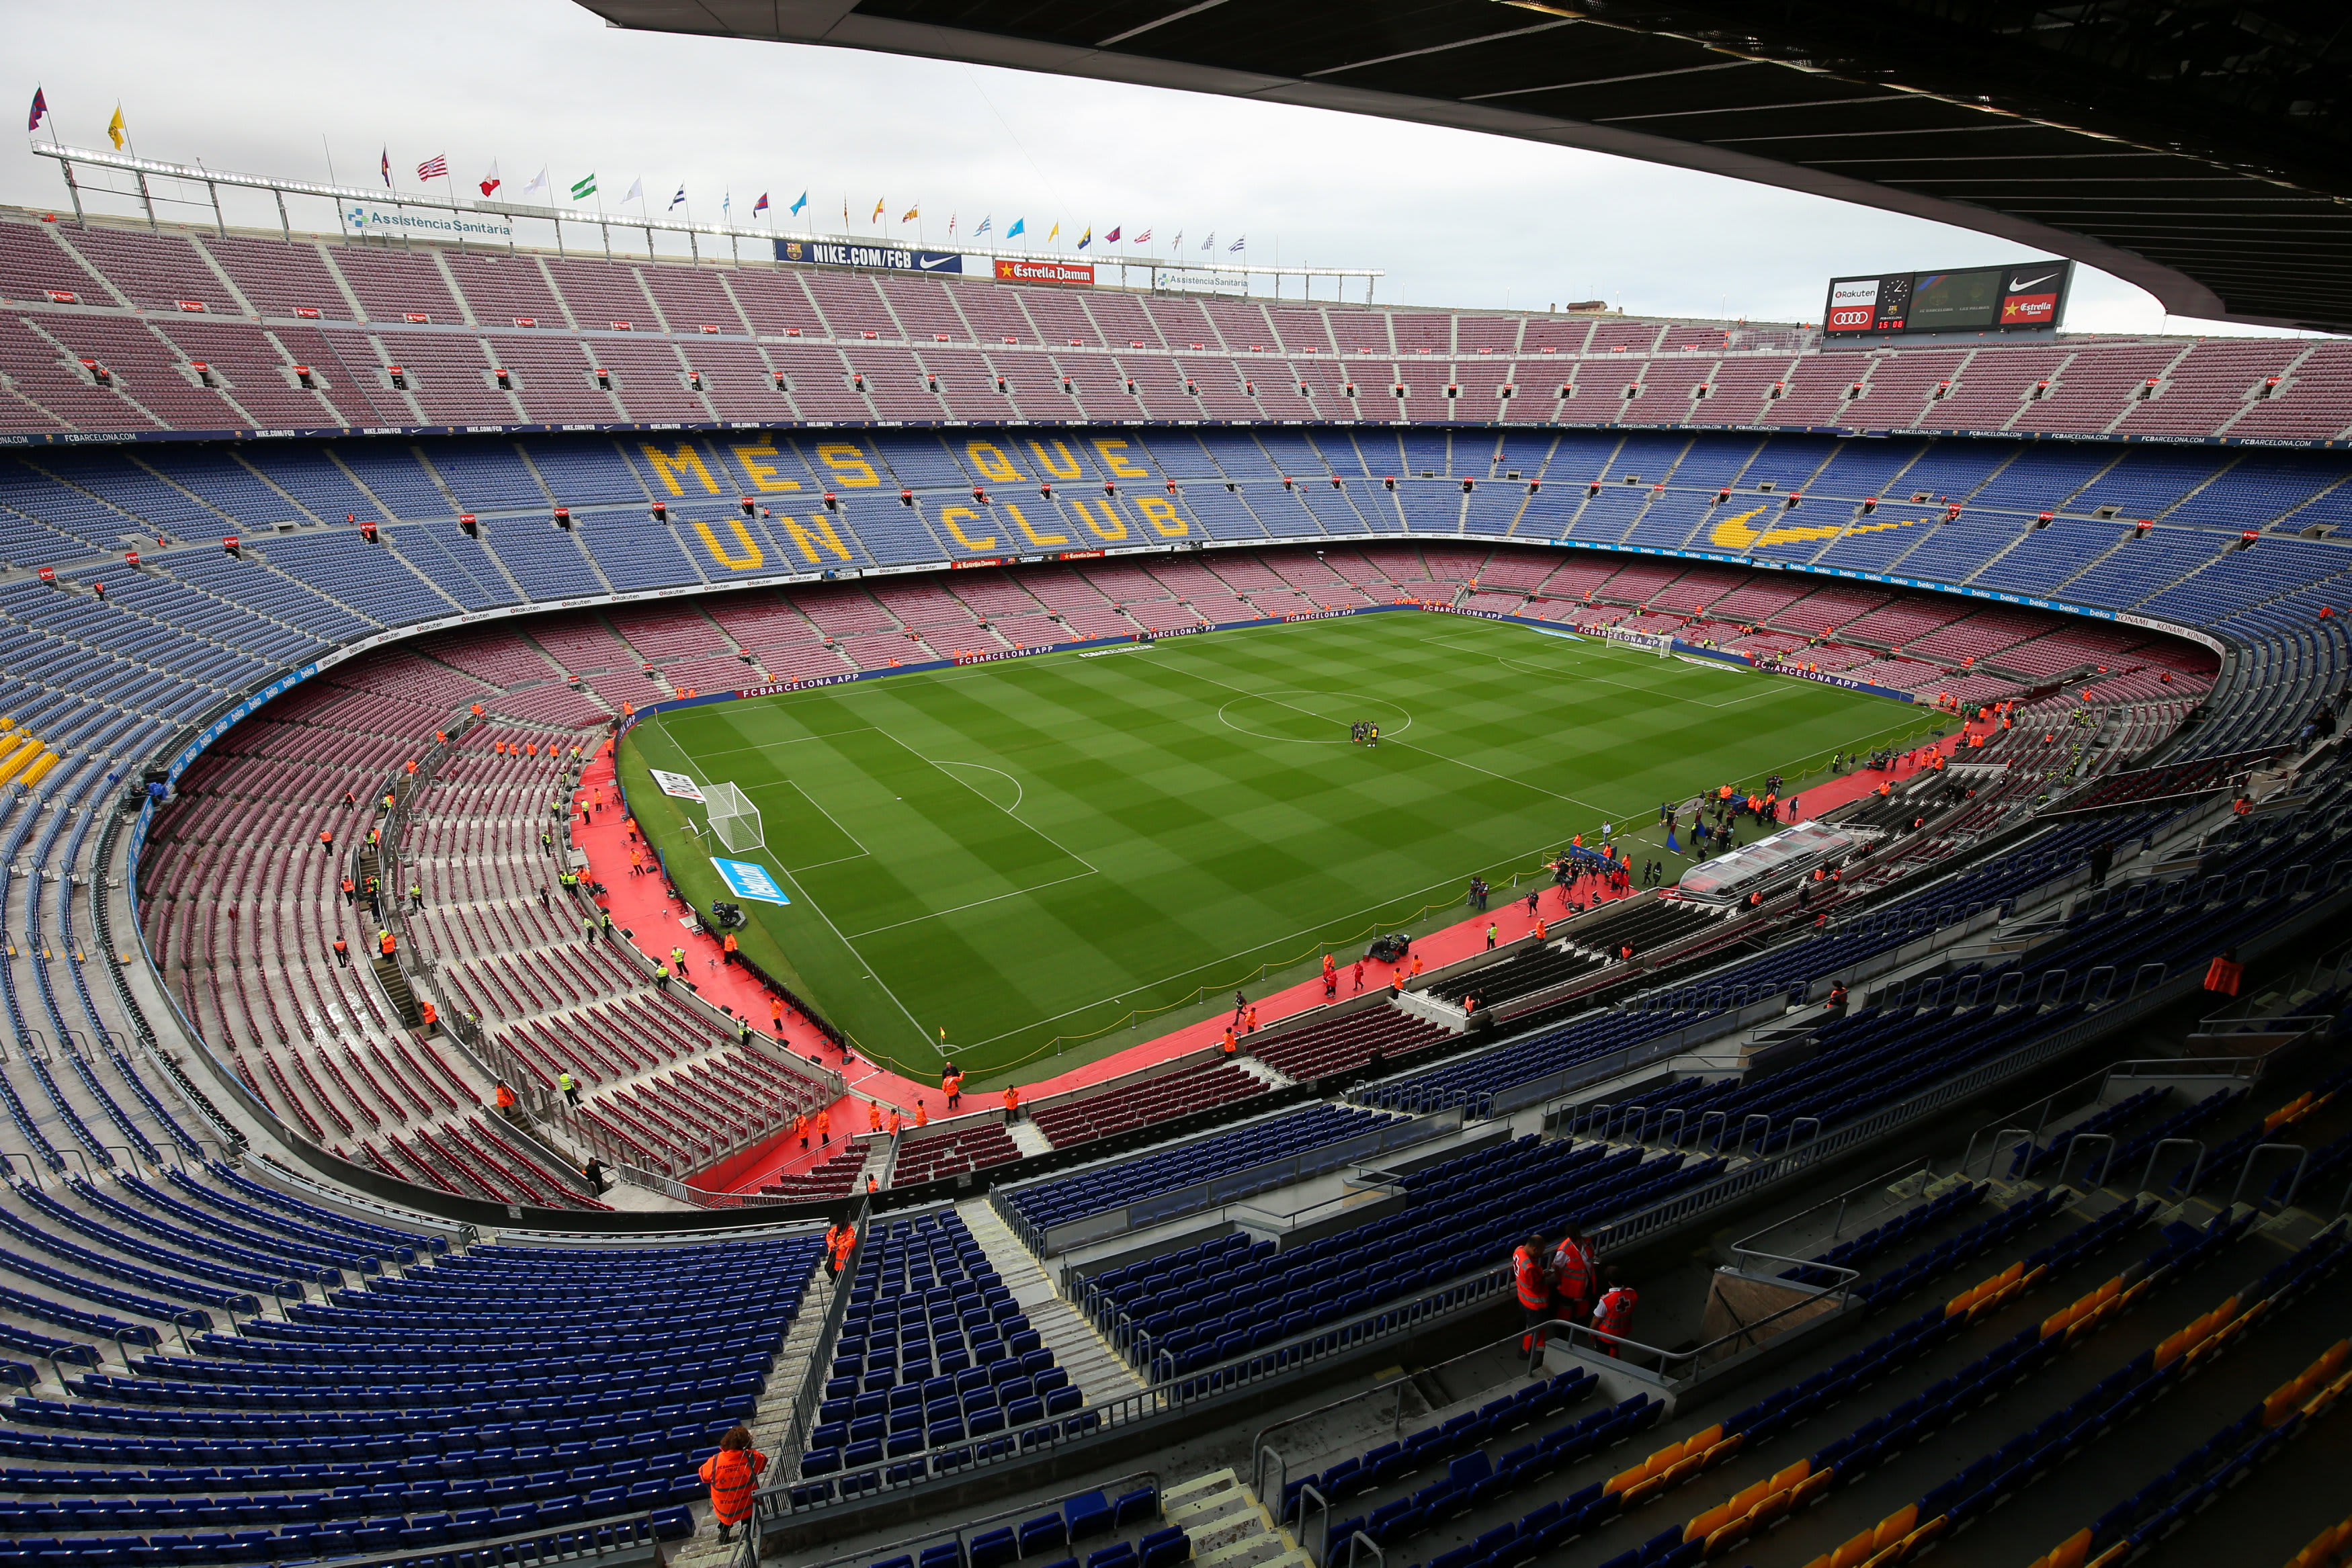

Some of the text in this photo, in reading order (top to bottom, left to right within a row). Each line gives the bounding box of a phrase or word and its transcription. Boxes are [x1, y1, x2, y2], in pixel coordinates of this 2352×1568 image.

[372, 211, 511, 236] Assistència Sanitària
[812, 244, 912, 269] NIKE.COM/FCB
[1013, 263, 1091, 281] Estrella Damm
[1170, 275, 1248, 288] Assistència Sanitària
[2020, 302, 2051, 311] Estrella
[1878, 321, 1888, 329] 15
[65, 433, 136, 442] FCBARCELONA.COM
[2240, 439, 2311, 447] FCBARCELONA.COM
[643, 432, 1148, 496] MÉS QUE
[694, 498, 1188, 570] UN CLUB
[962, 560, 979, 568] Estrella
[1790, 563, 1806, 571] beko
[1814, 566, 1831, 574] beko
[1839, 570, 1856, 578] beko
[1864, 573, 1882, 581] beko
[1890, 577, 1908, 585] beko
[1917, 581, 1935, 589] beko
[1944, 585, 1962, 593] beko
[1972, 589, 1990, 598] beko
[2000, 594, 2019, 603] beko
[2029, 599, 2049, 608] beko
[1423, 605, 1503, 620] FCBARCELONA APP
[2059, 603, 2079, 613] beko
[2089, 609, 2110, 618] beko
[462, 612, 490, 622] Rakuten
[1286, 609, 1355, 622] FCBARCELONA APP
[2115, 613, 2148, 626] KONAMI
[417, 621, 443, 632] Rakuten
[2156, 622, 2184, 636] KONAMI
[378, 631, 400, 642] Rakuten
[1136, 627, 1197, 640] FBARCELONA
[1579, 627, 1642, 644] FCBARCELONA
[1646, 638, 1664, 647] APP
[2186, 630, 2208, 644] KONAMI
[349, 643, 366, 654] Rakuten
[1079, 644, 1155, 658] FCBARCELONA.COM
[323, 655, 339, 667] Rakuten
[959, 645, 1054, 666] FCBARCELONA APP
[300, 666, 315, 679] beko
[1755, 660, 1831, 684] FCARCELONA
[1836, 679, 1858, 689] APP
[282, 676, 296, 689] beko
[743, 673, 859, 698] FCBARCELONA APP
[265, 686, 278, 699] beko
[248, 697, 261, 709] beko
[231, 709, 245, 722] beko
[214, 720, 228, 734] beko
[200, 734, 212, 748] beko
[185, 746, 196, 763] beko
[171, 761, 183, 778] beko
[730, 863, 781, 898] beko.com
